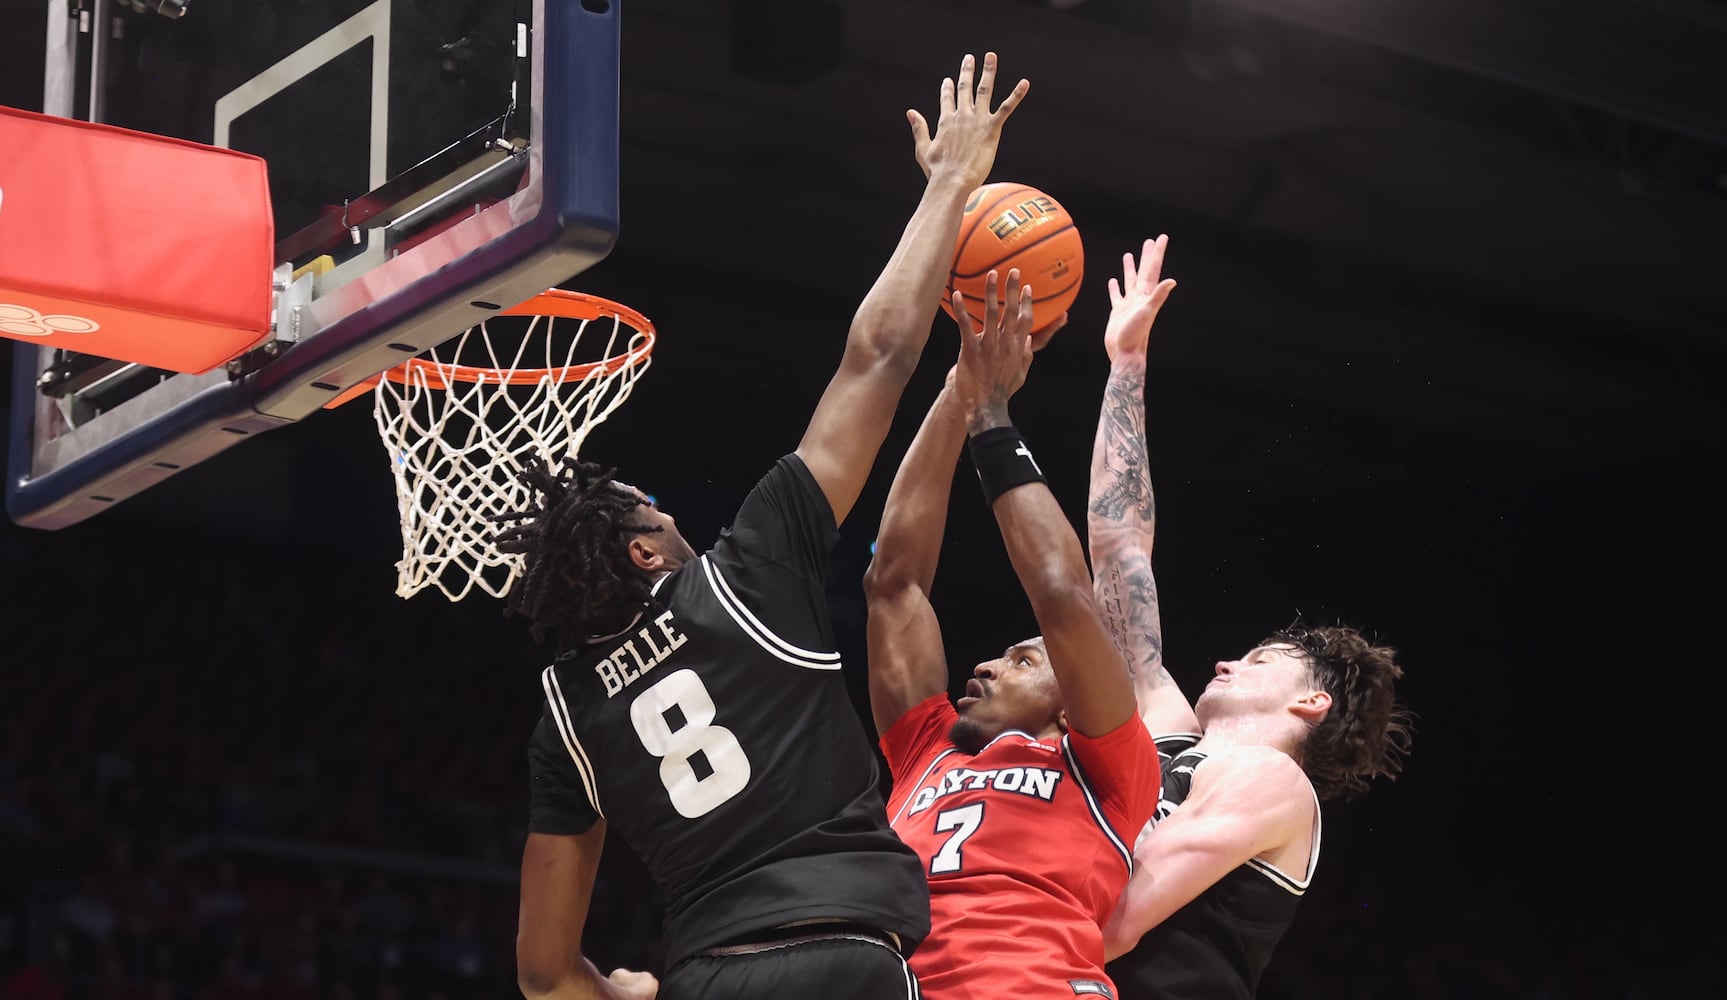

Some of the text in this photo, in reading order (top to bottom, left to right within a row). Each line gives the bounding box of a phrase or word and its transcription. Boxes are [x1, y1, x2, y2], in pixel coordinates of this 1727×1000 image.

[986, 196, 1058, 241] ELITE
[594, 609, 689, 699] BELLE
[629, 667, 752, 819] 8
[930, 801, 985, 876] 7
